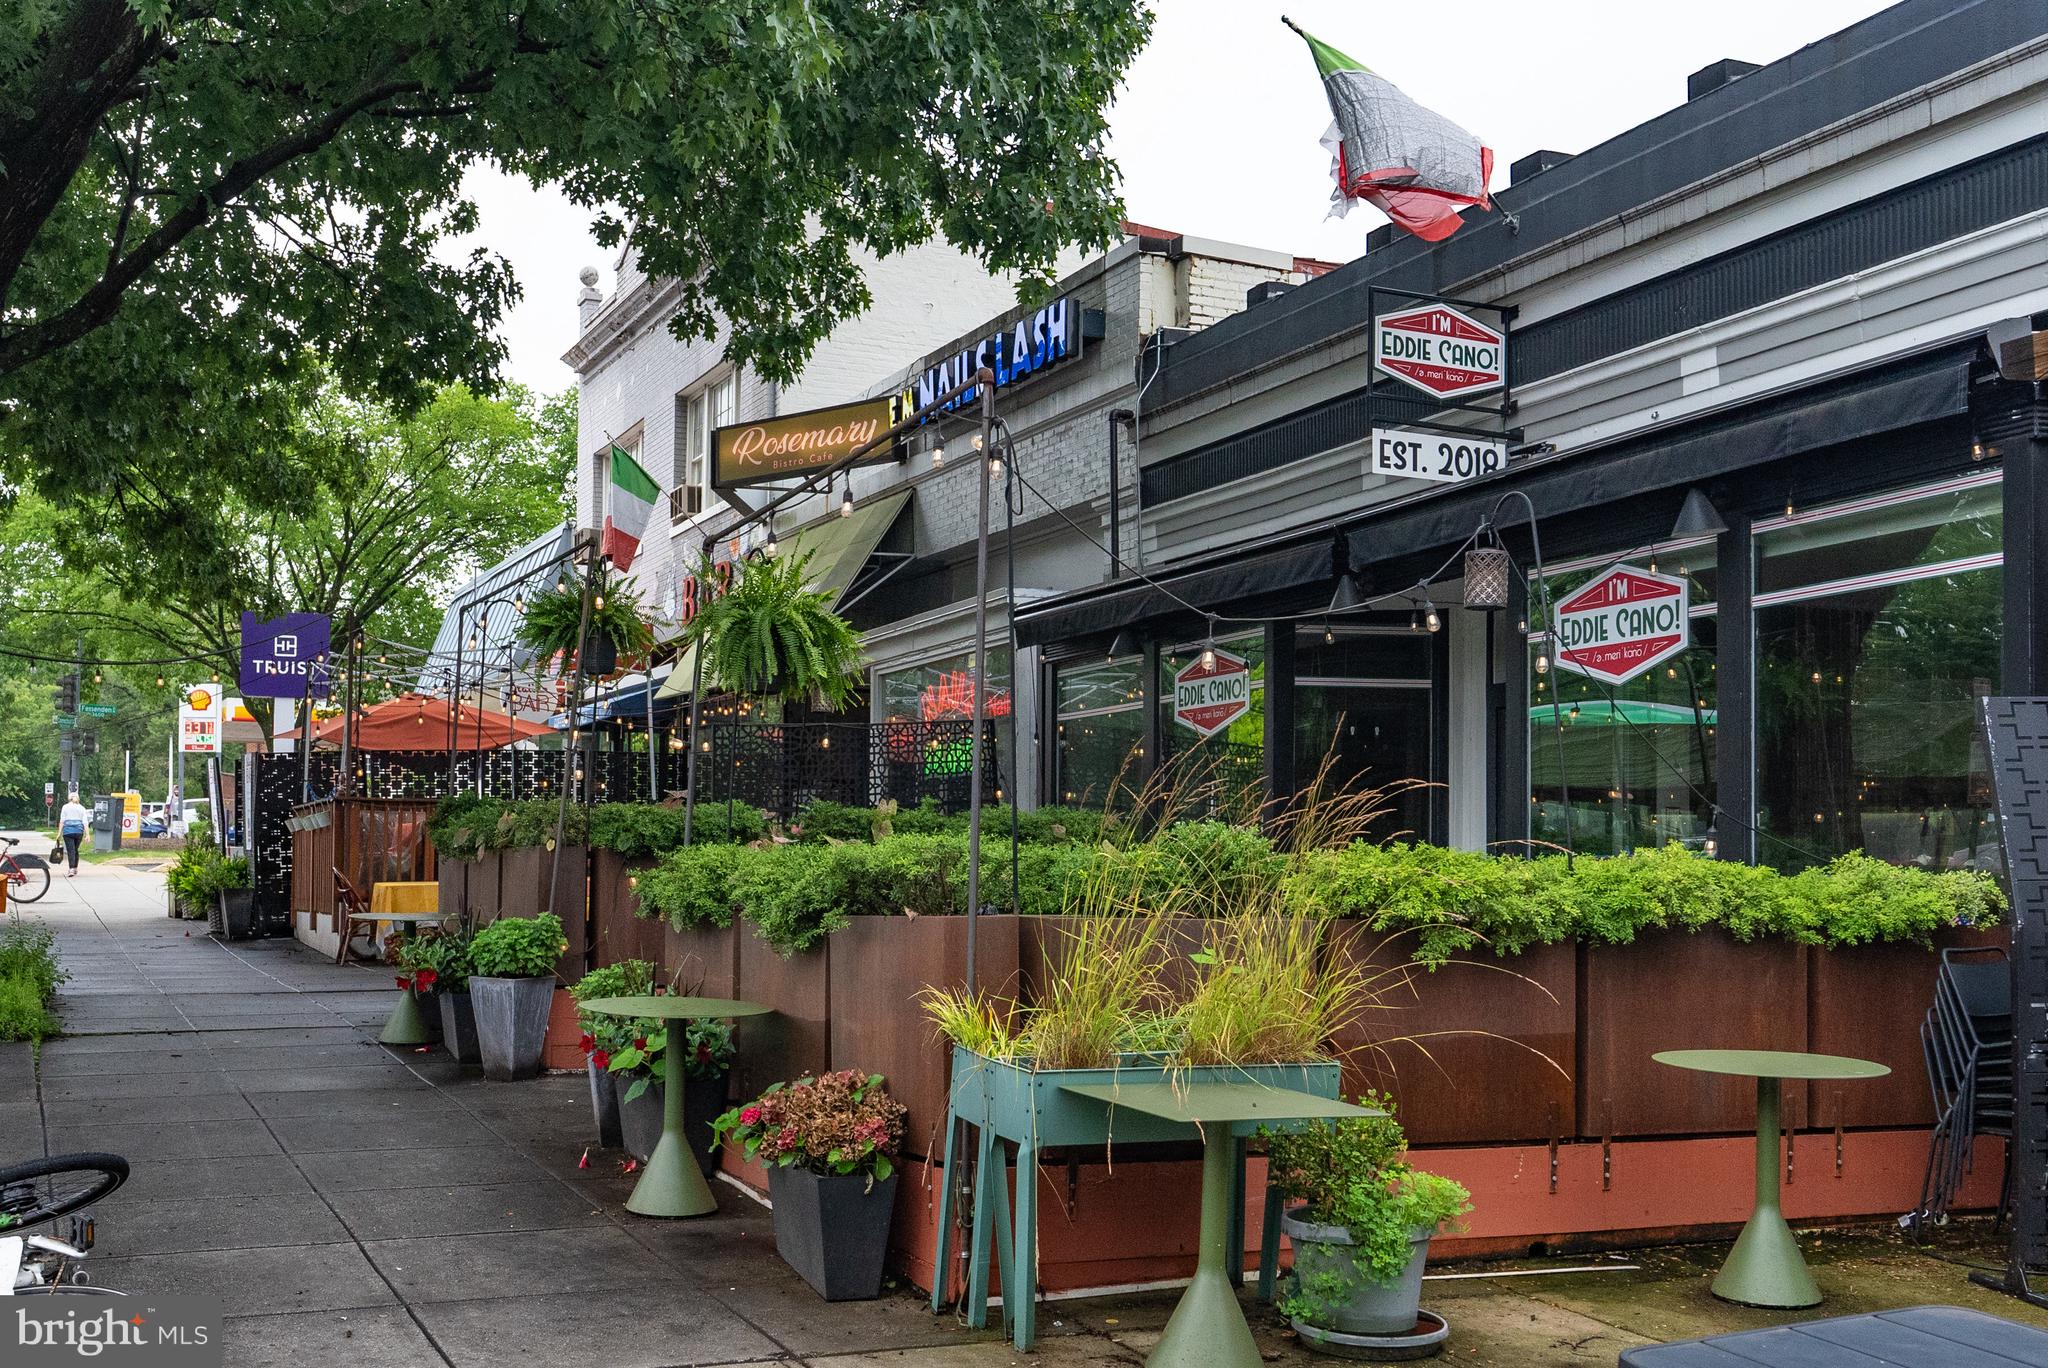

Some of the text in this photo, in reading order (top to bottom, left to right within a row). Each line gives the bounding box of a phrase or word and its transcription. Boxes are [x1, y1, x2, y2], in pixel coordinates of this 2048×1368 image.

[1432, 313, 1451, 333] I'M
[995, 298, 1067, 388] LASH
[1381, 330, 1499, 371] EDDIE CANO!
[732, 418, 877, 466] Rosemary
[1379, 438, 1499, 478] EST. 2018
[773, 457, 804, 469] Bistro
[1608, 577, 1628, 601] I'M
[1561, 599, 1680, 648] EDDIE CANO!
[252, 659, 312, 675] TRUIS
[1178, 675, 1246, 708] EDDIE CANO!
